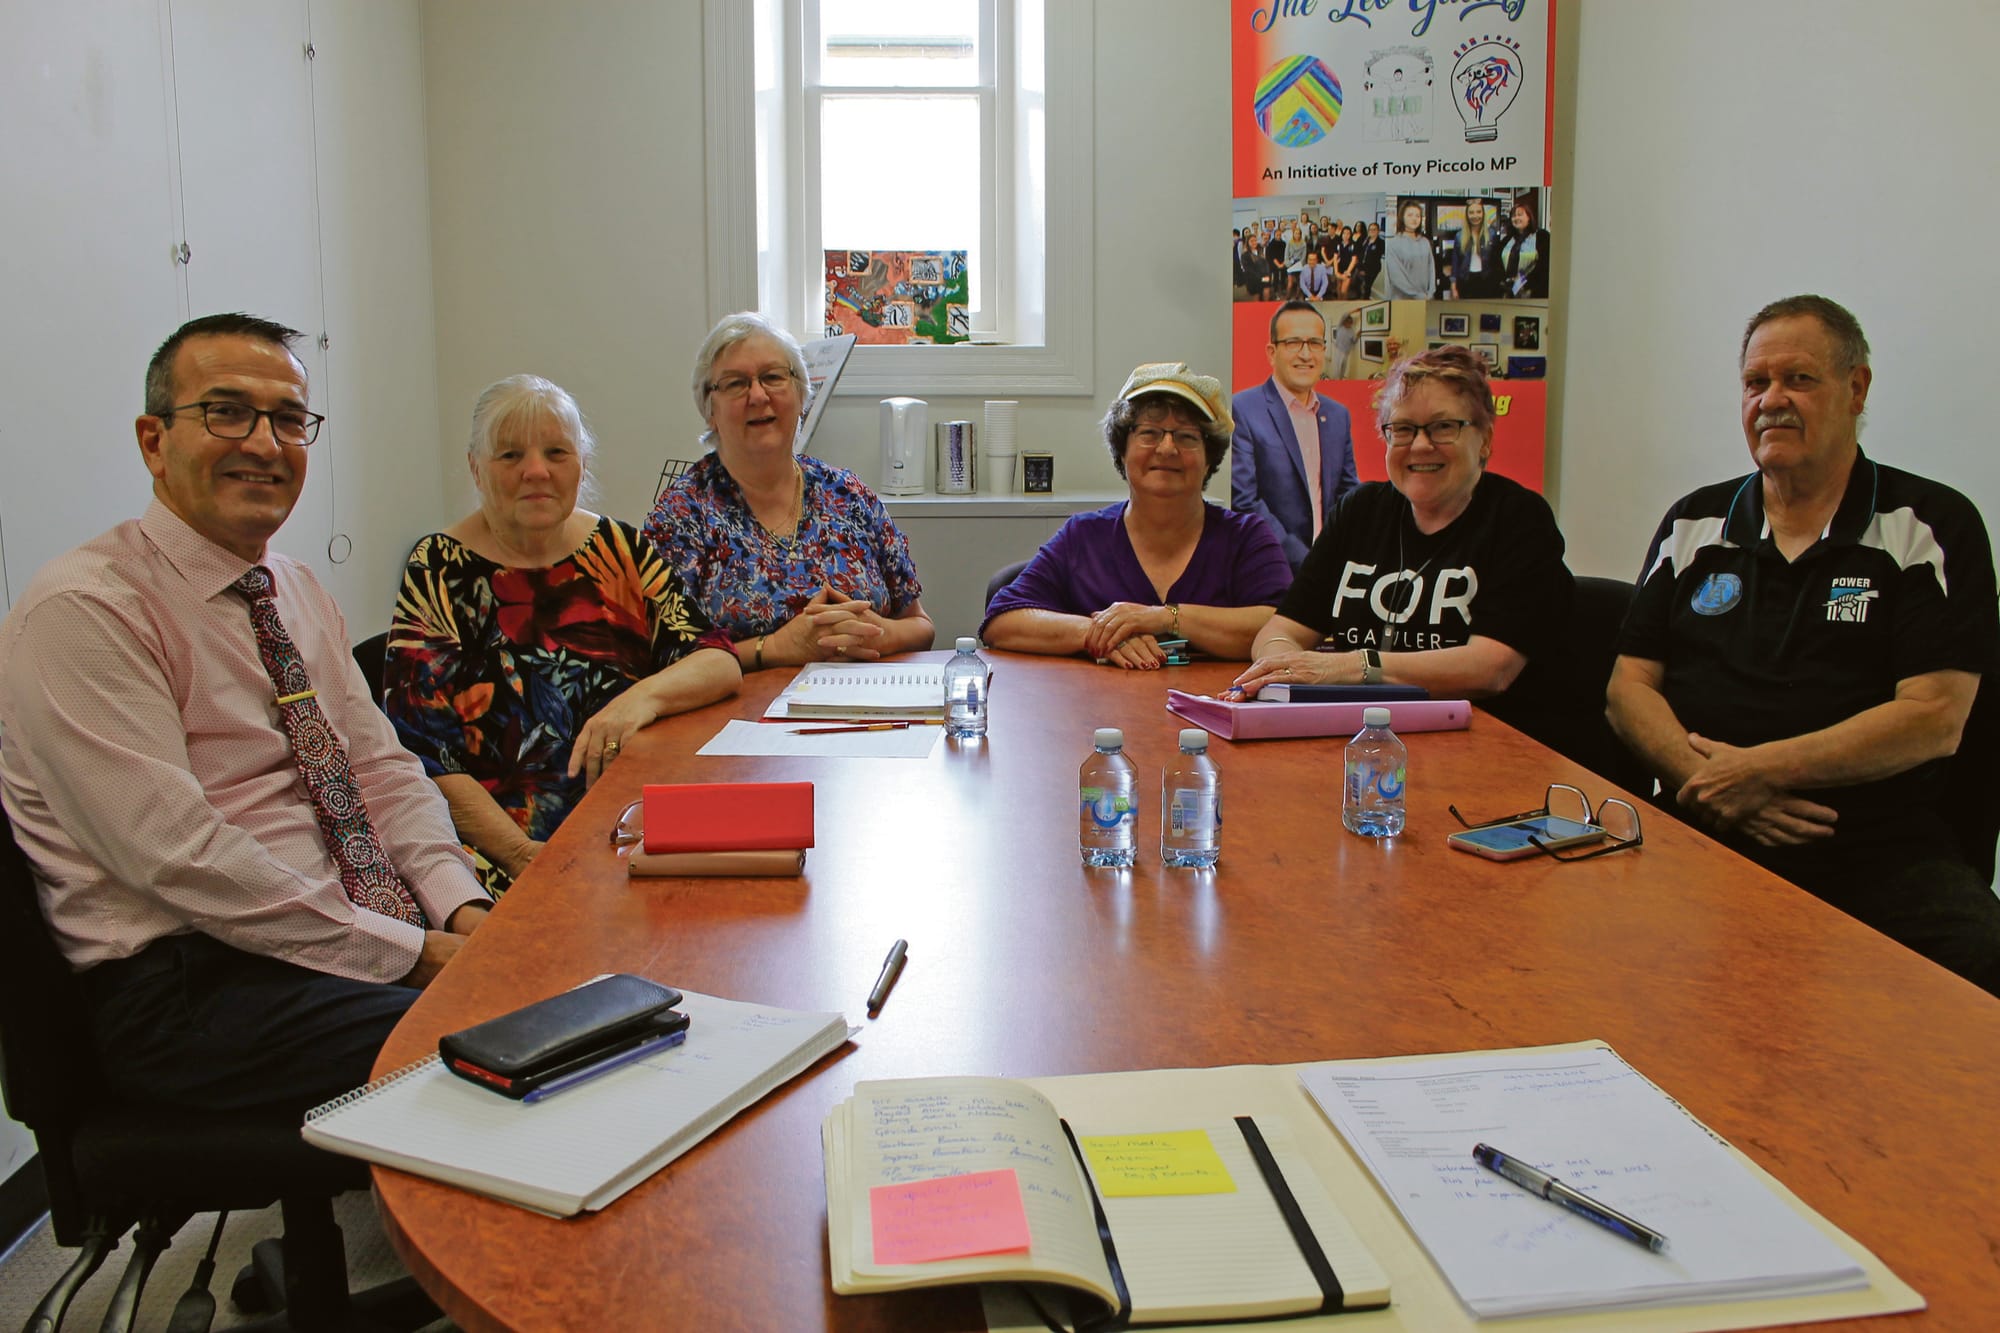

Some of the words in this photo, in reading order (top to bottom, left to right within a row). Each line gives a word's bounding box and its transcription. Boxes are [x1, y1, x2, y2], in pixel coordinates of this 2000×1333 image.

[1261, 167, 1283, 181] An
[1288, 164, 1358, 179] Initiative
[1362, 161, 1379, 177] of
[1382, 161, 1422, 178] Tony
[1426, 158, 1486, 174] Piccolo
[1490, 156, 1517, 171] MP
[1332, 560, 1479, 625] FOR
[1831, 577, 1871, 588] POWER
